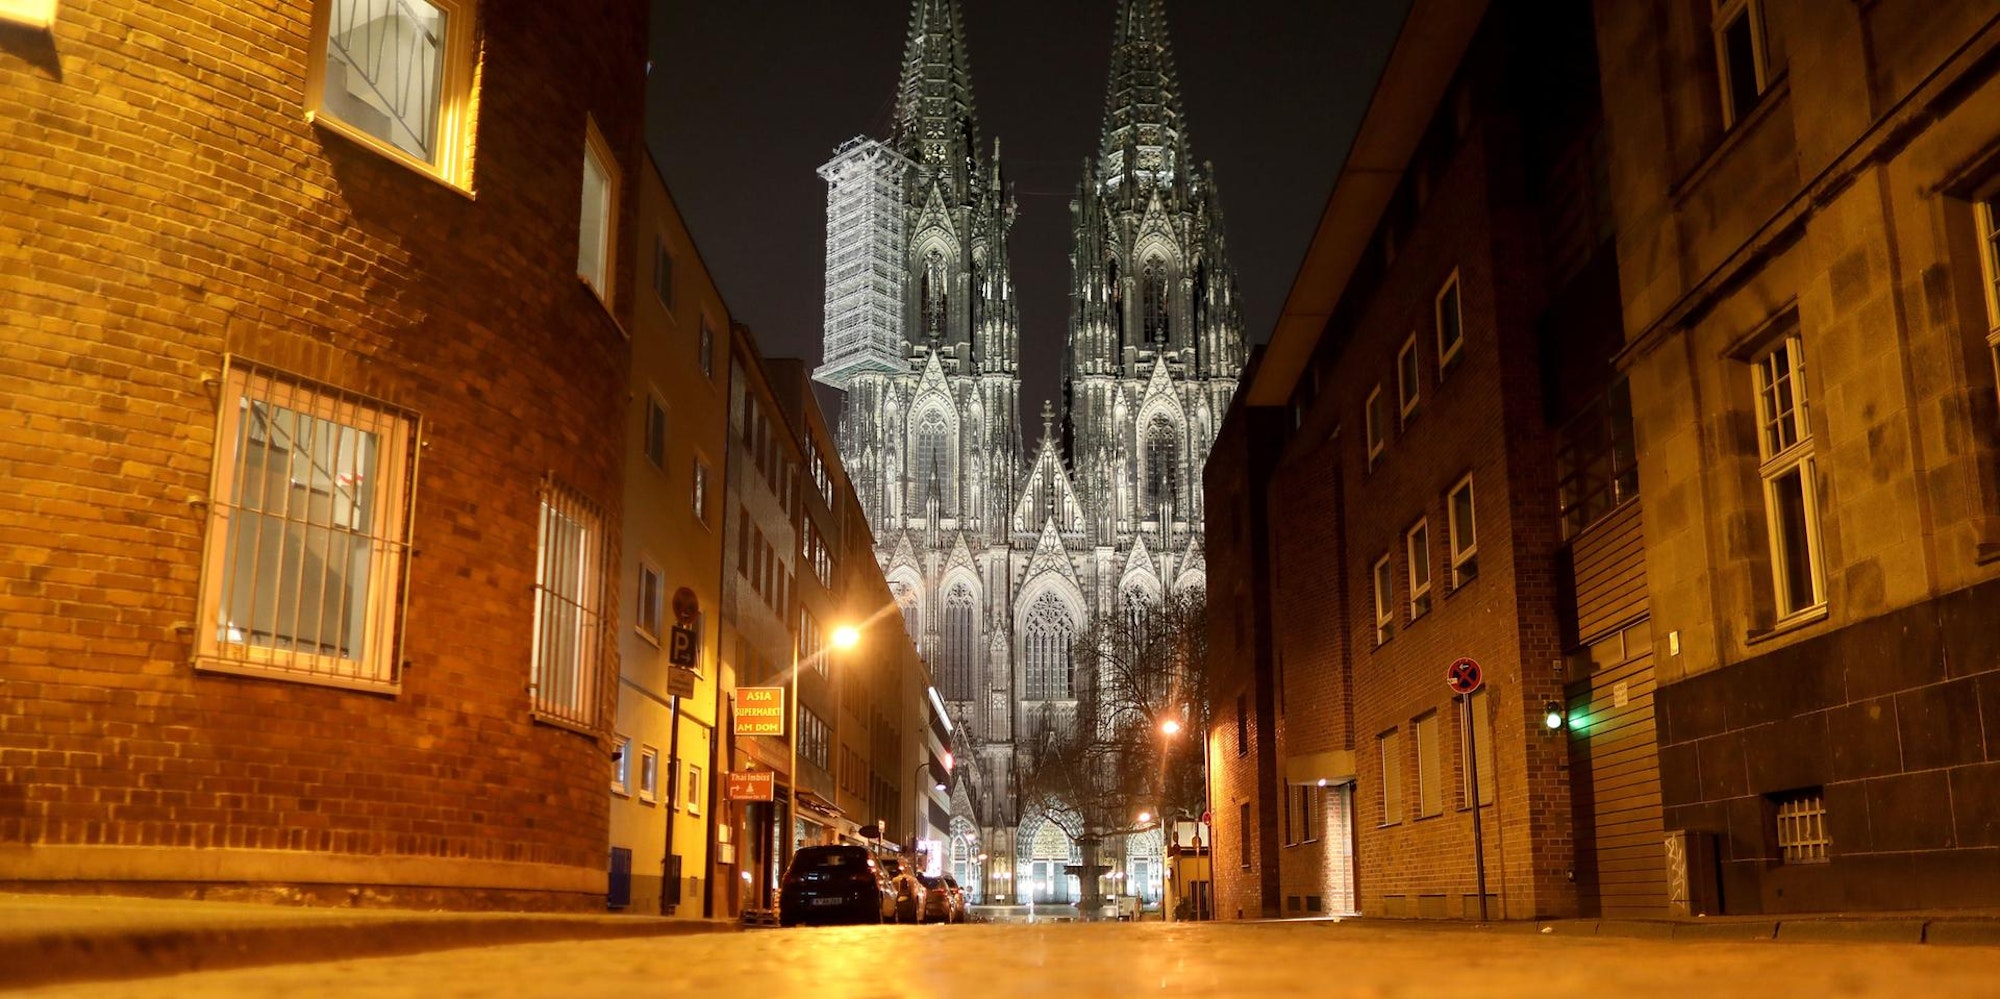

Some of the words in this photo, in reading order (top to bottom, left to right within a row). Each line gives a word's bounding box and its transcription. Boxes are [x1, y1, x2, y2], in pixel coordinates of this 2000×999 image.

[674, 631, 690, 660] P
[746, 691, 772, 701] ASIA
[735, 707, 780, 717] SUPERMARKT
[737, 723, 753, 732] AM
[755, 723, 778, 732] DOM
[731, 773, 747, 781] Thai
